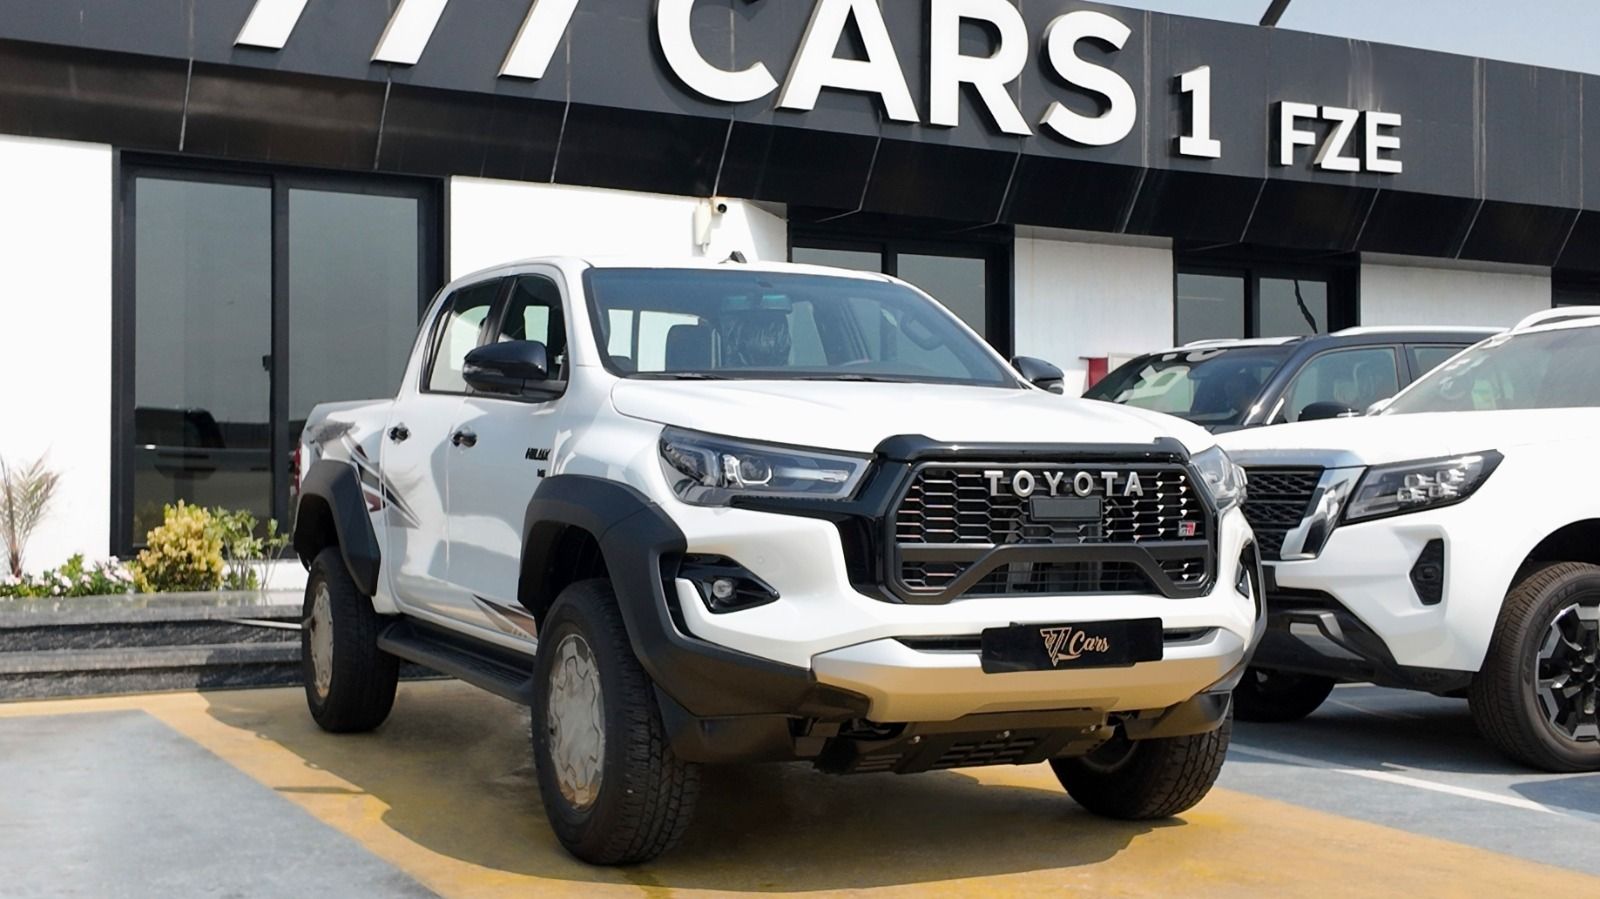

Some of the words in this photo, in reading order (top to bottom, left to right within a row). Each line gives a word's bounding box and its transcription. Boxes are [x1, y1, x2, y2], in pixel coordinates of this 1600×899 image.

[656, 0, 1137, 146] CARS
[1176, 65, 1221, 158] 1
[1276, 100, 1403, 173] FZE
[984, 470, 1144, 498] TOYOTA
[1069, 630, 1110, 656] Cars
